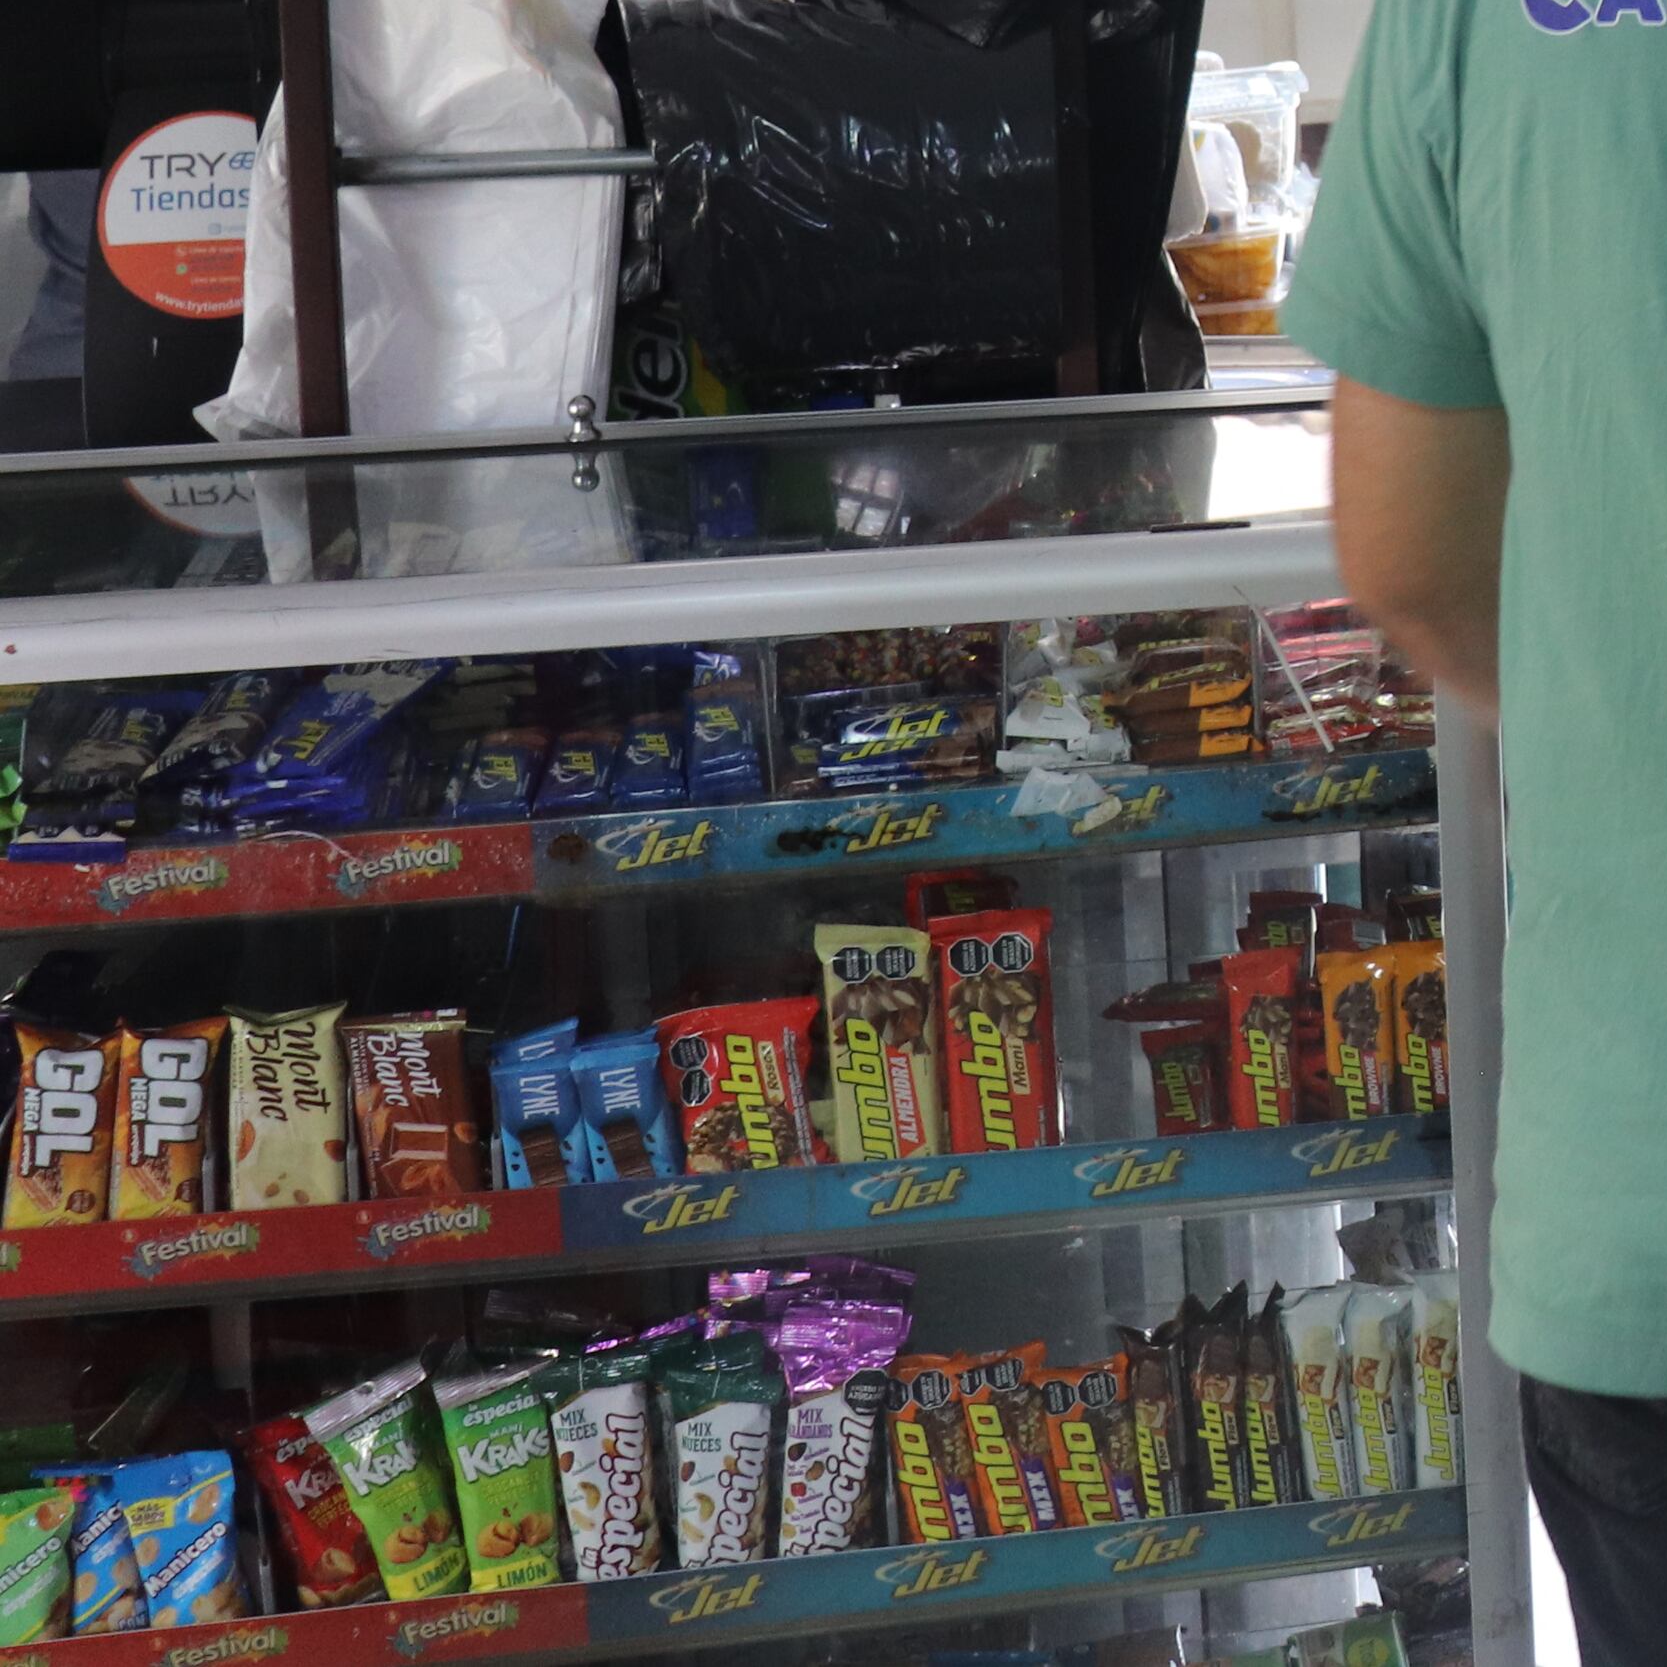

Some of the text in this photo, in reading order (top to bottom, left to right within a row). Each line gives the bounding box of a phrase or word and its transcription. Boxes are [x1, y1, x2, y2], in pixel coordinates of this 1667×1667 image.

[140, 152, 228, 180] TRY
[131, 182, 251, 213] Tiendas
[1290, 765, 1382, 815] Jet
[615, 820, 712, 872] Jet
[845, 802, 942, 854] Jet
[106, 859, 218, 902] Festival
[345, 840, 452, 883] Festival
[246, 1028, 288, 1122] Blanc
[282, 1021, 331, 1114] Mont
[366, 1033, 409, 1108] Blanc
[396, 1029, 443, 1099] Mont
[837, 1017, 897, 1162] umbo
[960, 1010, 1018, 1151] umbo
[1241, 1029, 1281, 1128] umbo
[1334, 1044, 1368, 1121] mbo
[1402, 1034, 1435, 1117] mbo
[518, 1074, 561, 1121] LYNE
[601, 1066, 642, 1115] LYNE
[720, 1033, 780, 1171] umbo
[889, 1055, 920, 1145] ALMENDRA
[1091, 1148, 1186, 1199] Jet
[1309, 1128, 1400, 1178] Jet
[641, 1185, 742, 1235] Jet
[870, 1165, 967, 1216] Jet
[139, 1223, 248, 1266] Festival
[374, 1205, 480, 1248] Festival
[559, 1408, 587, 1426] MIX
[687, 1421, 713, 1438] MIX
[799, 1407, 823, 1425] MIX
[284, 1466, 342, 1510] KRA
[341, 1438, 420, 1497] KRAK
[804, 1414, 875, 1556] pecial
[895, 1419, 953, 1544] mbo
[967, 1403, 1034, 1535] umbo
[1058, 1420, 1117, 1527] mbo
[701, 1430, 770, 1568] pecial
[1025, 1470, 1056, 1521] MIX
[1113, 1525, 1206, 1573] Jet
[1326, 1503, 1416, 1548] Jet
[0, 1536, 62, 1596] nicero
[144, 1522, 227, 1598] Manicero
[411, 1550, 461, 1592] LIMÓN
[496, 1562, 548, 1589] LIMÓN
[894, 1548, 989, 1597] Jet
[404, 1598, 513, 1647] Festival
[669, 1573, 765, 1624] Jet
[169, 1627, 278, 1667] Festival
